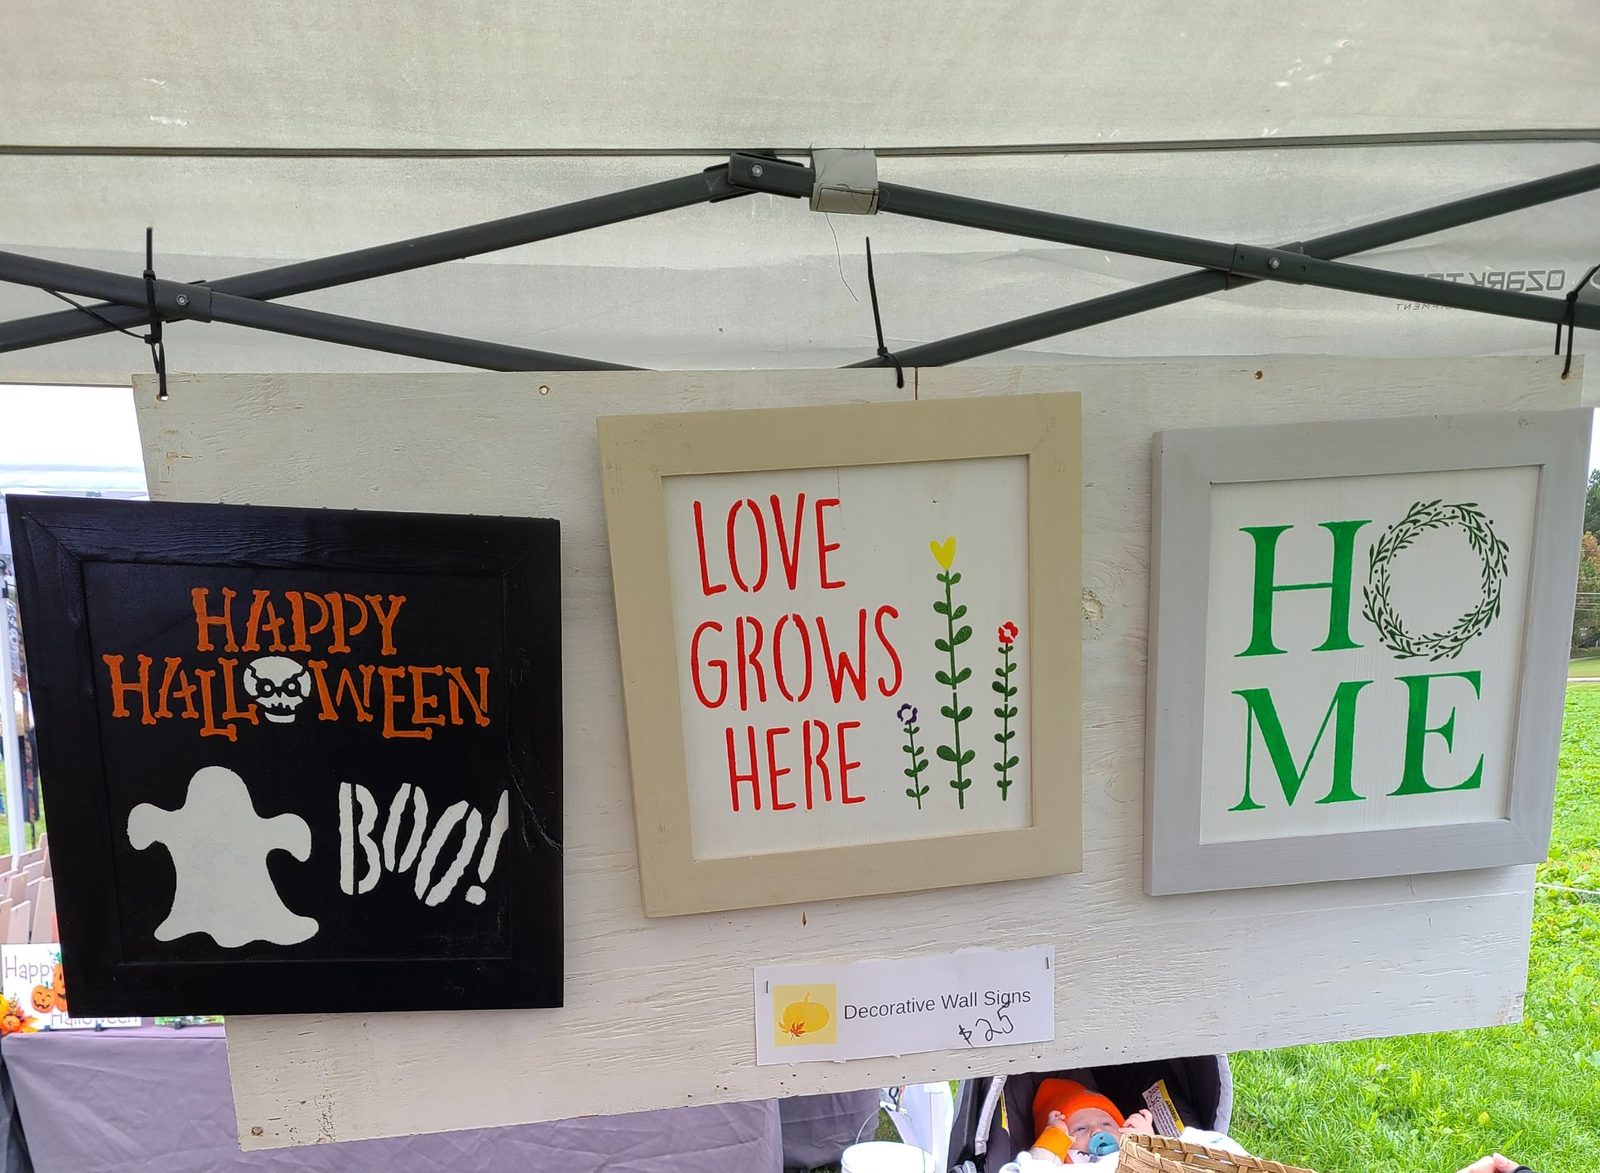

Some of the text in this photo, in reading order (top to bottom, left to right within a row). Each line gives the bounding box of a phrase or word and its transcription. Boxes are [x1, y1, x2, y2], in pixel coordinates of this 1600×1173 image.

[693, 493, 846, 596] LOVE
[191, 587, 407, 655] HAPPY
[691, 605, 902, 711] GROWS
[726, 719, 865, 812] HERE
[1227, 670, 1485, 812] ME
[338, 781, 509, 907] BOO!
[844, 990, 1031, 1020] Decorative Wall Signs
[959, 1002, 1013, 1048] $25
